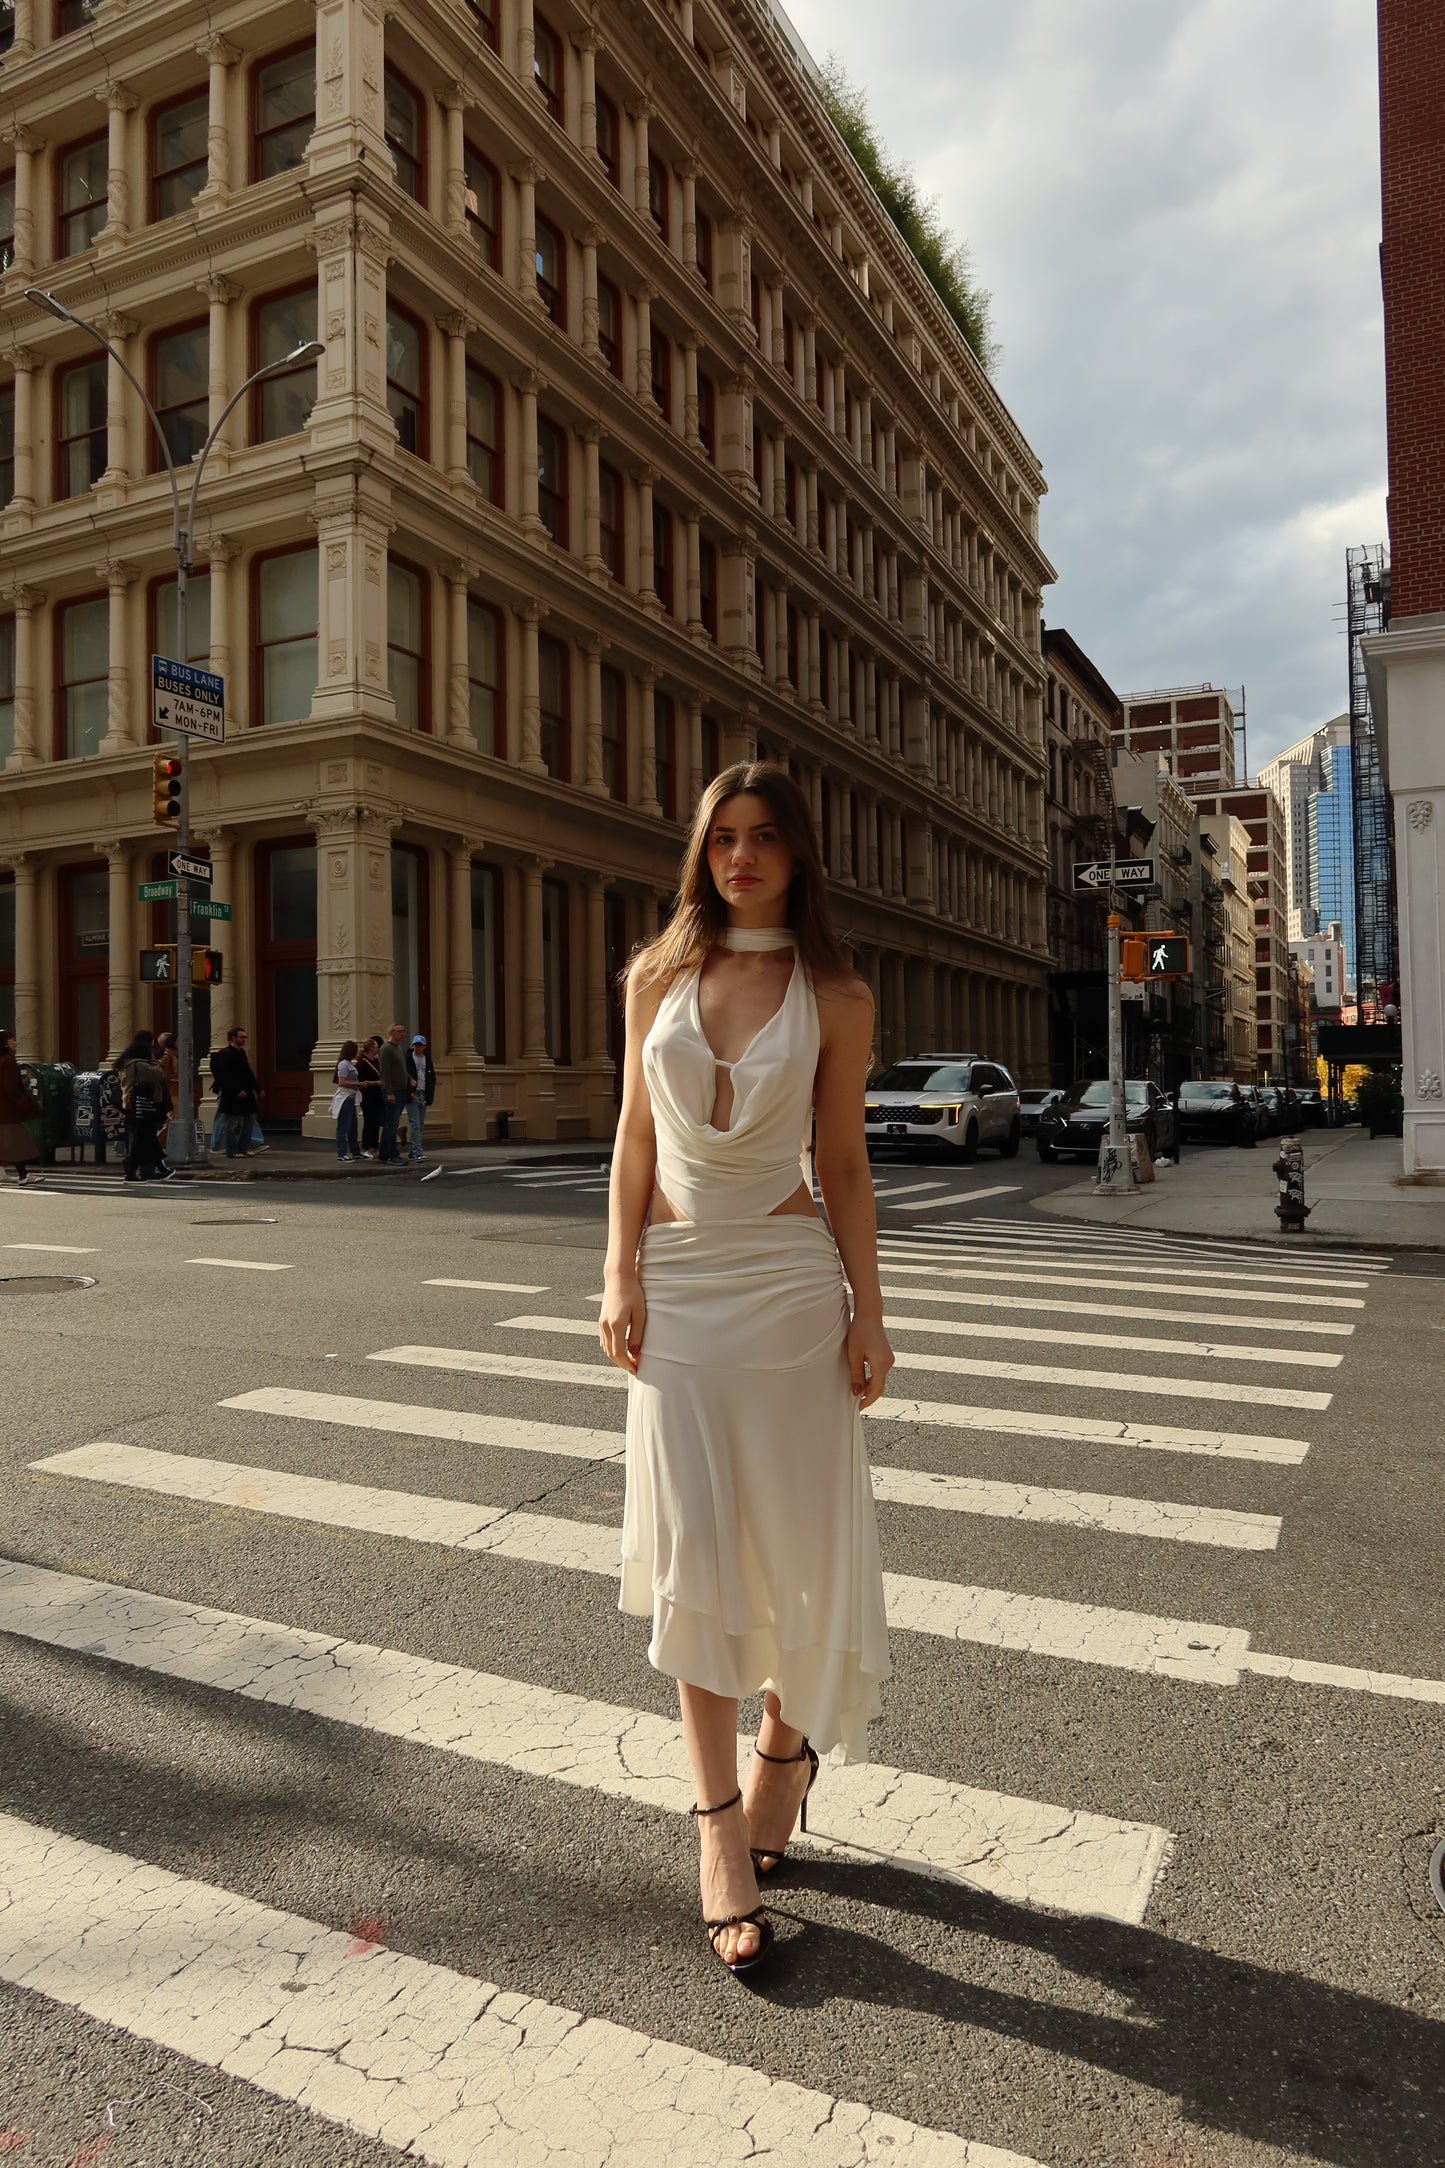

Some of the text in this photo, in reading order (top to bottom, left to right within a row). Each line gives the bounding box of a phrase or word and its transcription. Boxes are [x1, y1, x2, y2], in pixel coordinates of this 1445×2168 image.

[171, 665, 220, 690] BUS LANE
[158, 676, 220, 704] BUSES ONLY
[173, 698, 221, 722] 7AM-6PM
[175, 714, 219, 737] MON-FRI
[176, 859, 208, 877] ONE WAY
[1089, 867, 1145, 881] ONE WAY
[143, 884, 173, 898] Broadway
[192, 900, 222, 918] Franklin
